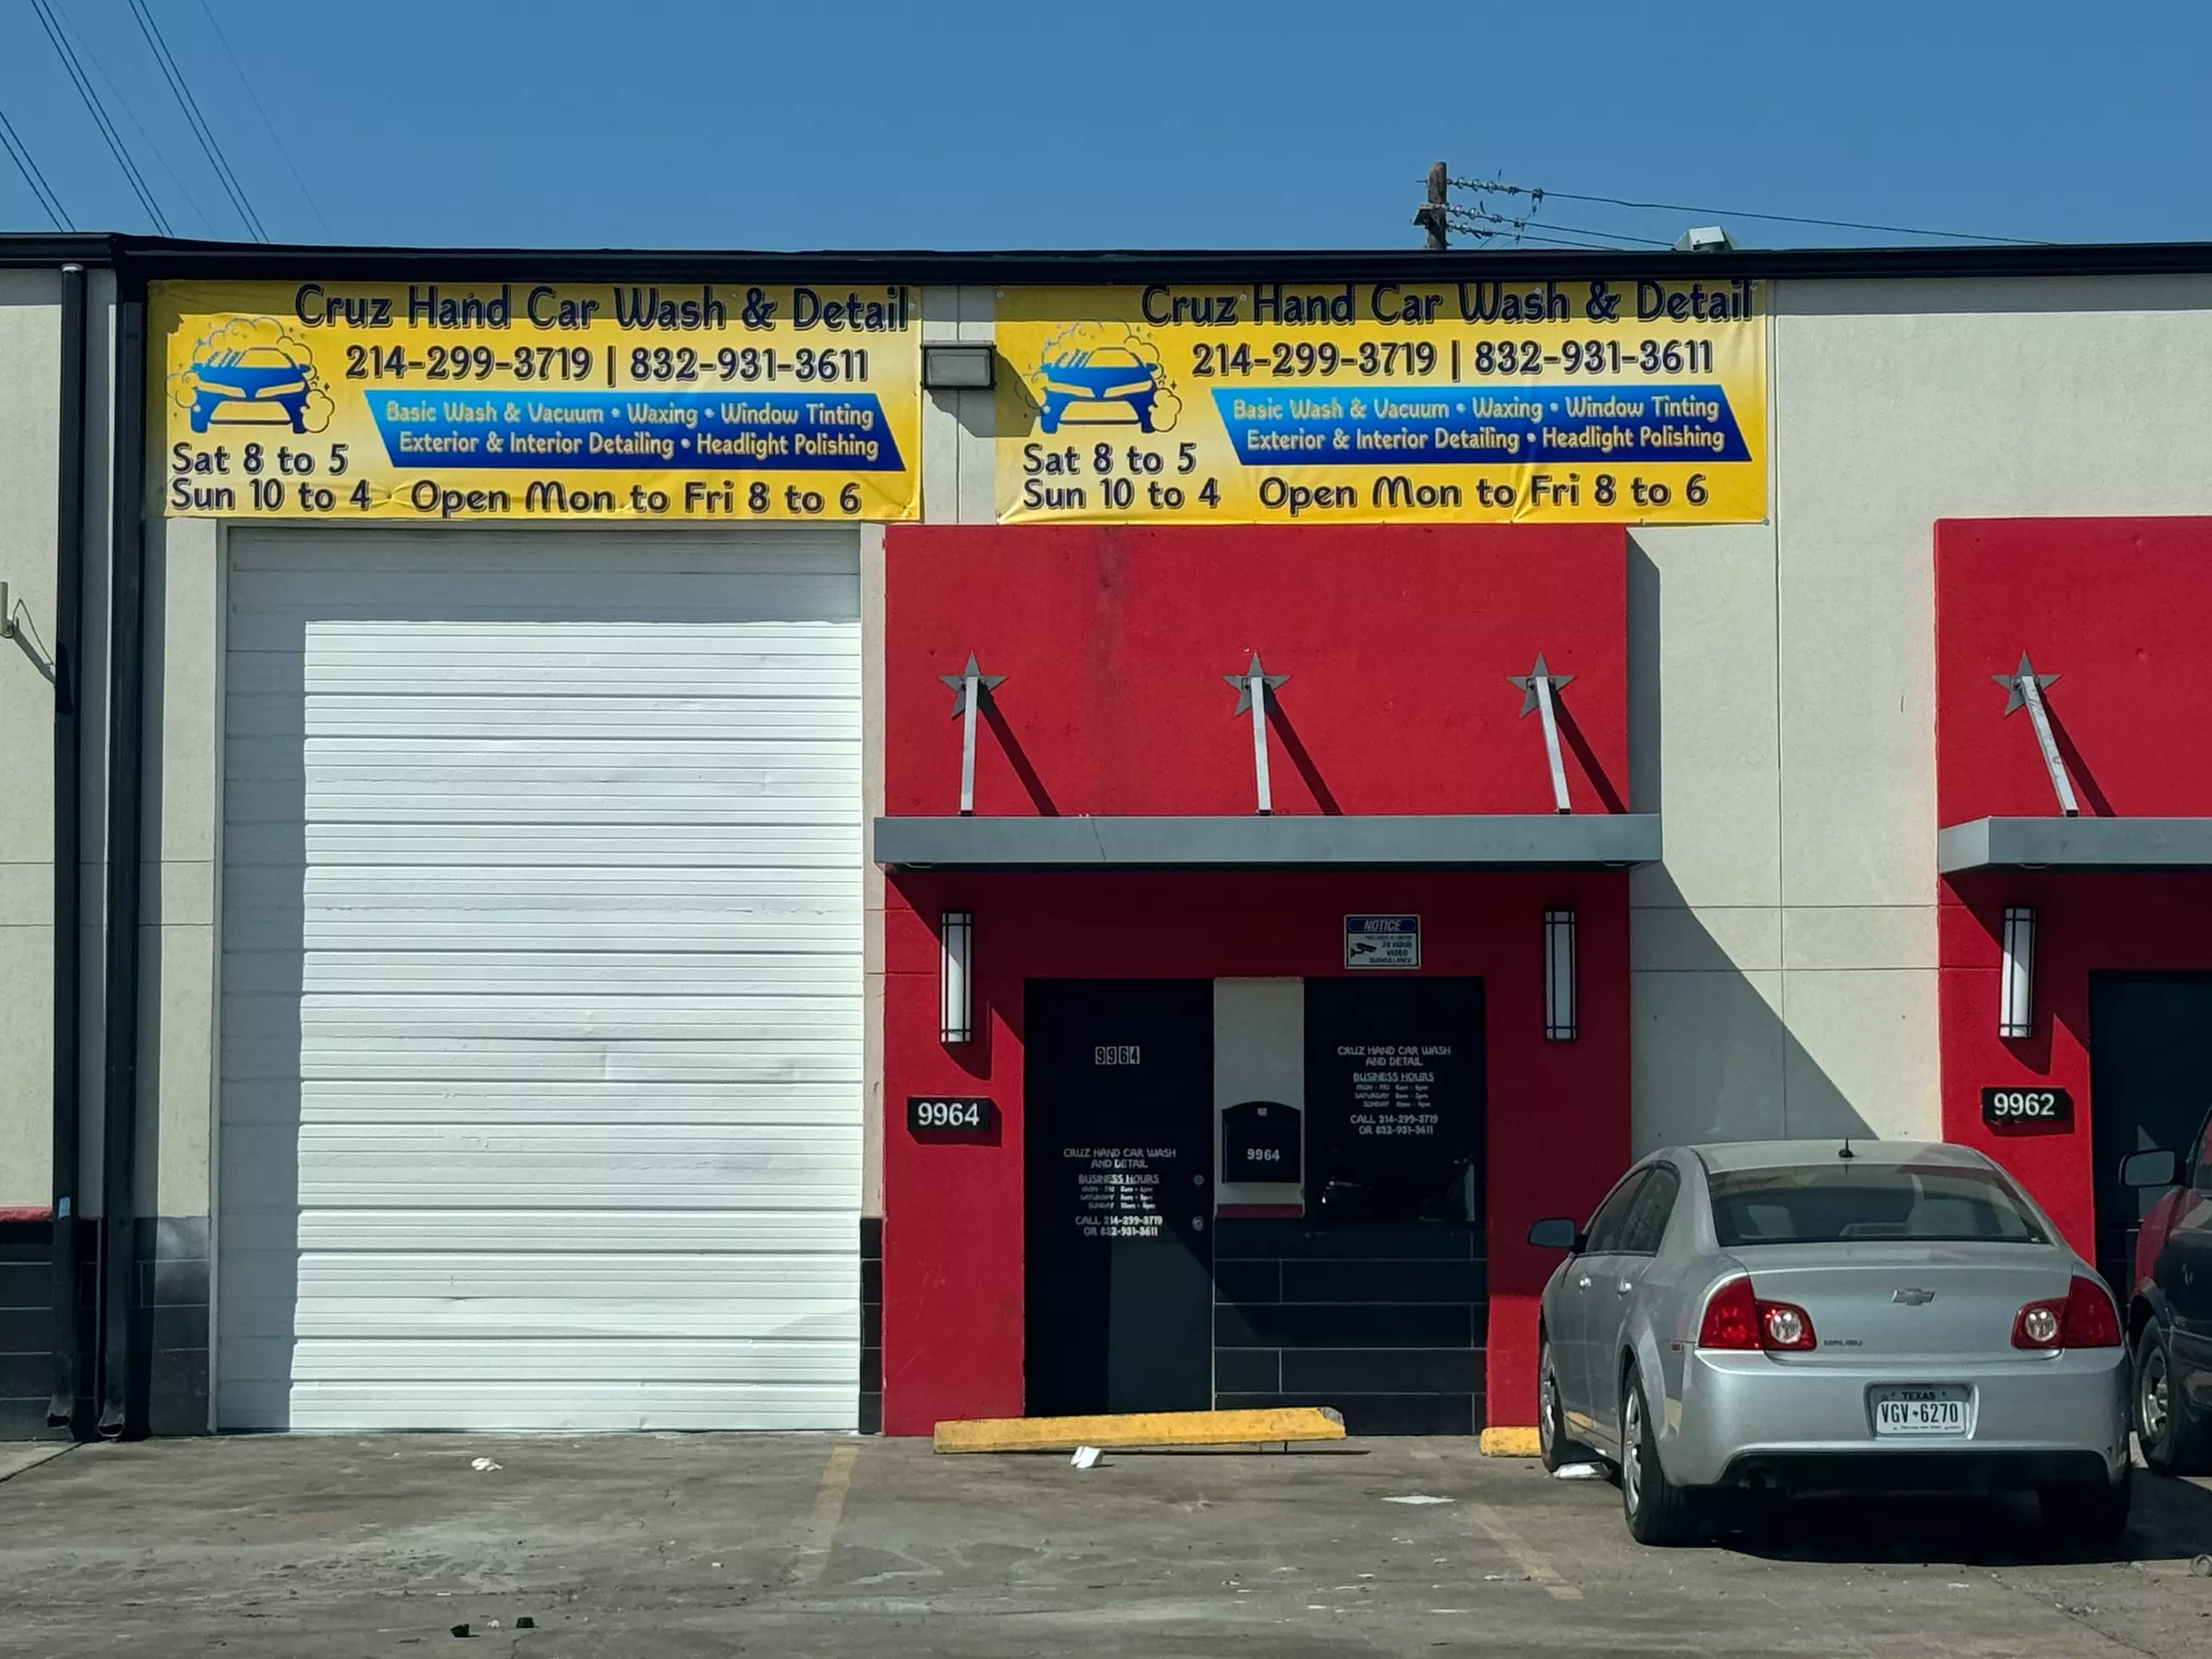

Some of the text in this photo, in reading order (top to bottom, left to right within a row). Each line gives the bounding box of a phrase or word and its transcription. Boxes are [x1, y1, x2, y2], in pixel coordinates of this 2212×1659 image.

[295, 285, 909, 332] Cruz Hand Car Wash & Detail
[1143, 279, 1753, 328] Cruz Hand Car Wash & Detail
[346, 345, 593, 382] 214-299-3719
[630, 346, 868, 382] 832-931-3611
[1192, 341, 1437, 378] 214-299-3719
[1475, 339, 1713, 376] 832-931-3611
[386, 402, 874, 430] Basic Wash & Vacuum Waxing Window Tinting
[1233, 394, 1719, 423] Basic Wash & Vacuum Waxing Window Tinting
[399, 431, 878, 461] Exterior & Interior Detailing Headlight Polishing
[1247, 426, 1724, 454] Exterior & Interior Detailing Headlight Polishing
[171, 442, 349, 475] Sat 8 to 5
[1023, 442, 1197, 474] Sat 8 to 5
[171, 478, 371, 511] Sun 10 to 4
[411, 479, 862, 519] Open Mon to Fri 8 to 6
[1023, 477, 1219, 510] Sun 10 to 4
[1260, 475, 1707, 517] Open Mon to Fri 8 to 6
[1364, 919, 1402, 932] NOTICE
[1095, 1045, 1140, 1065] 9964
[1337, 1045, 1452, 1056] CRUZ HAND CAR WASH
[1365, 1056, 1423, 1066] AND DETAIL
[1353, 1072, 1434, 1082] BUSINESS HOURS
[918, 1102, 980, 1126] 9964
[1994, 1093, 2055, 1115] 9962
[1349, 1114, 1438, 1124] CALL 214-299-3719
[1359, 1124, 1434, 1135] OR 832-931-3611
[1063, 1147, 1176, 1158] CRUZ HAND CAR WASH
[1091, 1159, 1148, 1169] AND DETAIL
[1247, 1148, 1280, 1161] 9964
[1078, 1174, 1159, 1184] BUSINESS HOURS
[1075, 1215, 1163, 1225] CALL 214-299-3719
[1084, 1226, 1158, 1236] OR 832-931-3611
[1901, 1392, 1936, 1400] TEXAS
